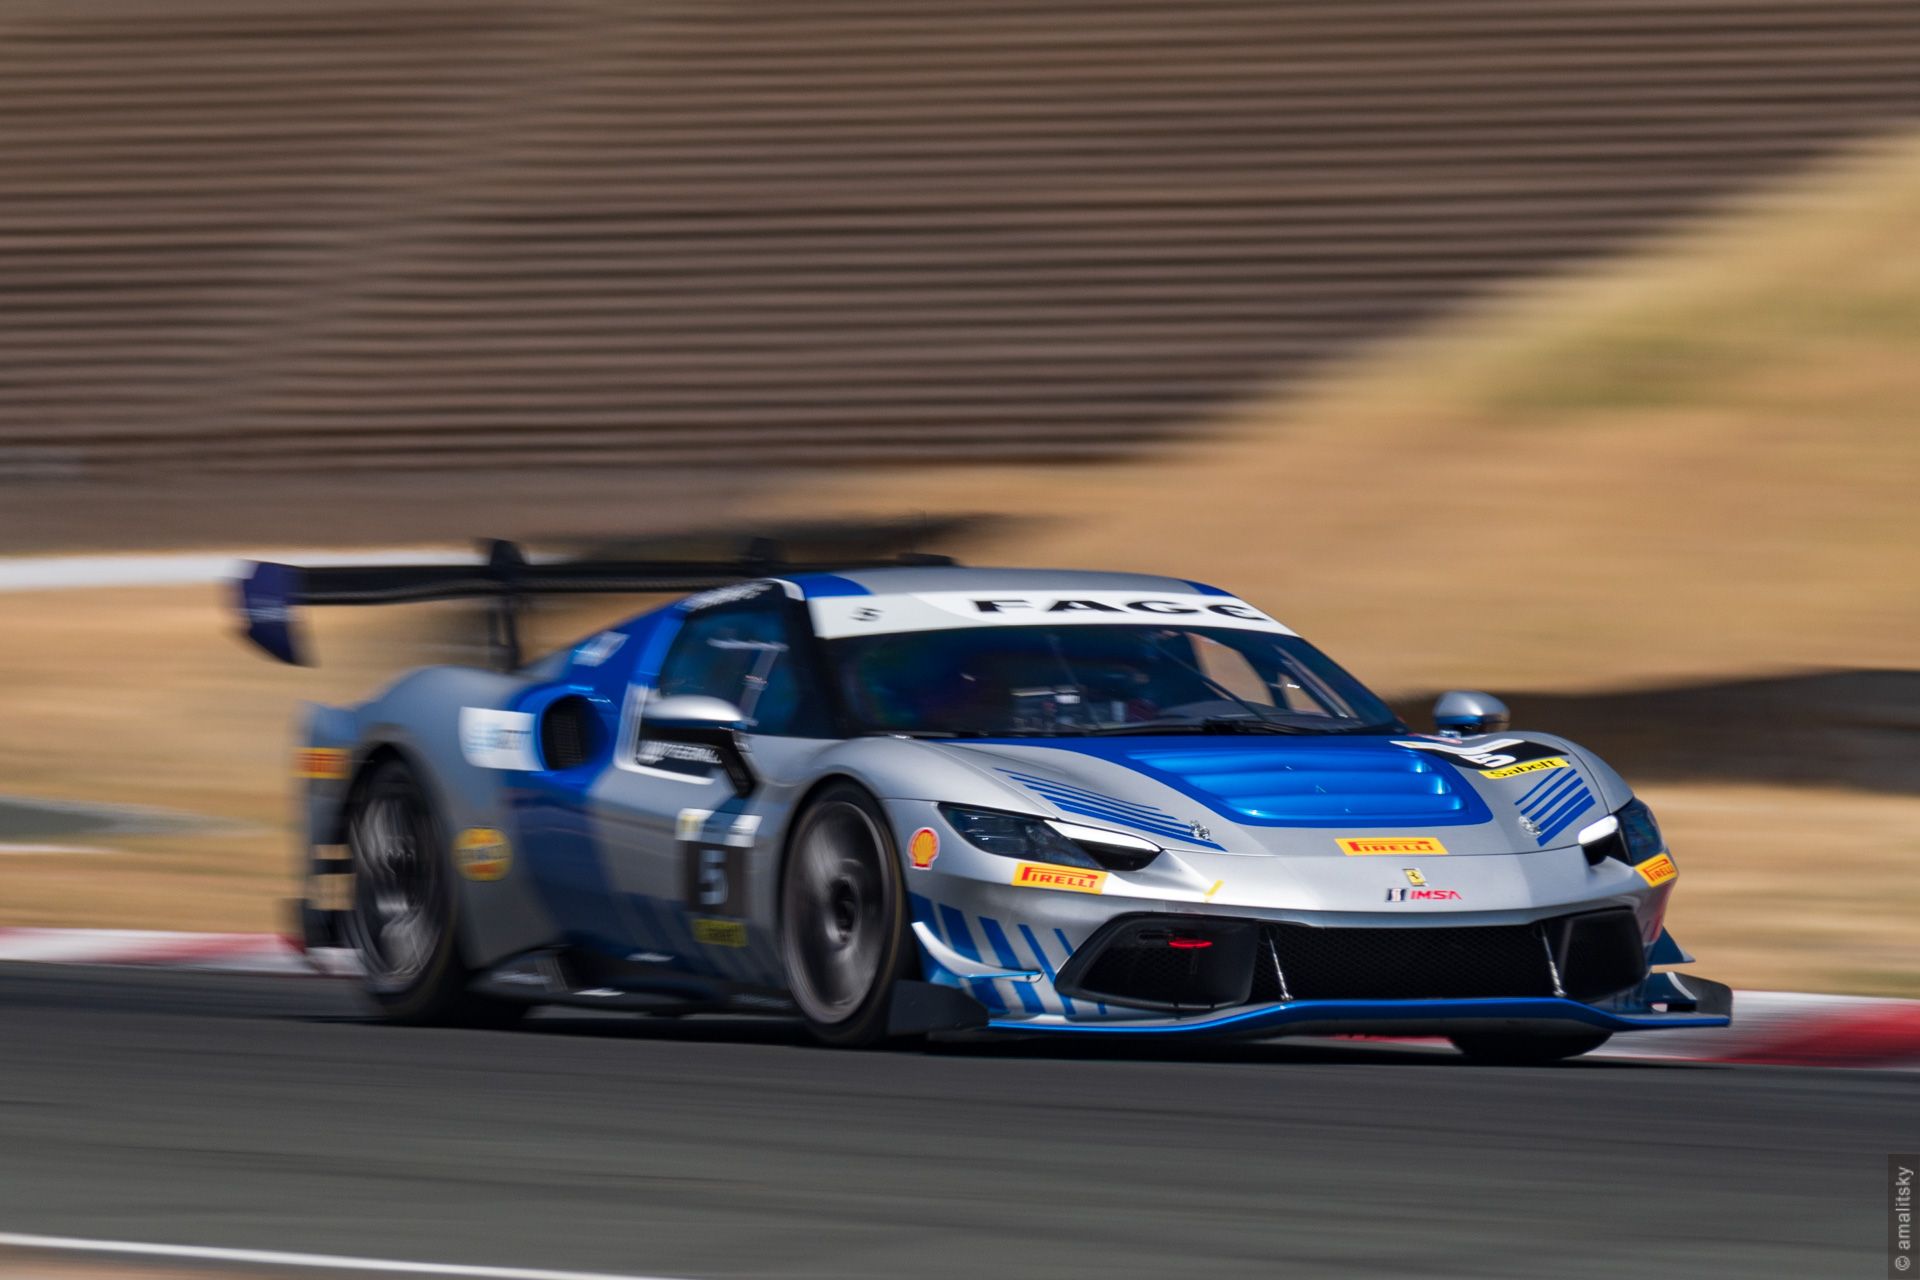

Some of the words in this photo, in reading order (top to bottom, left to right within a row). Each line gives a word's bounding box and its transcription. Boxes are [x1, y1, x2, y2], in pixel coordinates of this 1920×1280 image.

[1459, 753, 1517, 769] 5
[1490, 758, 1557, 778] Sabelt
[1347, 841, 1435, 852] PIRELLI
[699, 850, 728, 905] 5
[1021, 867, 1098, 888] PIRELLI
[1410, 890, 1462, 900] IMSA
